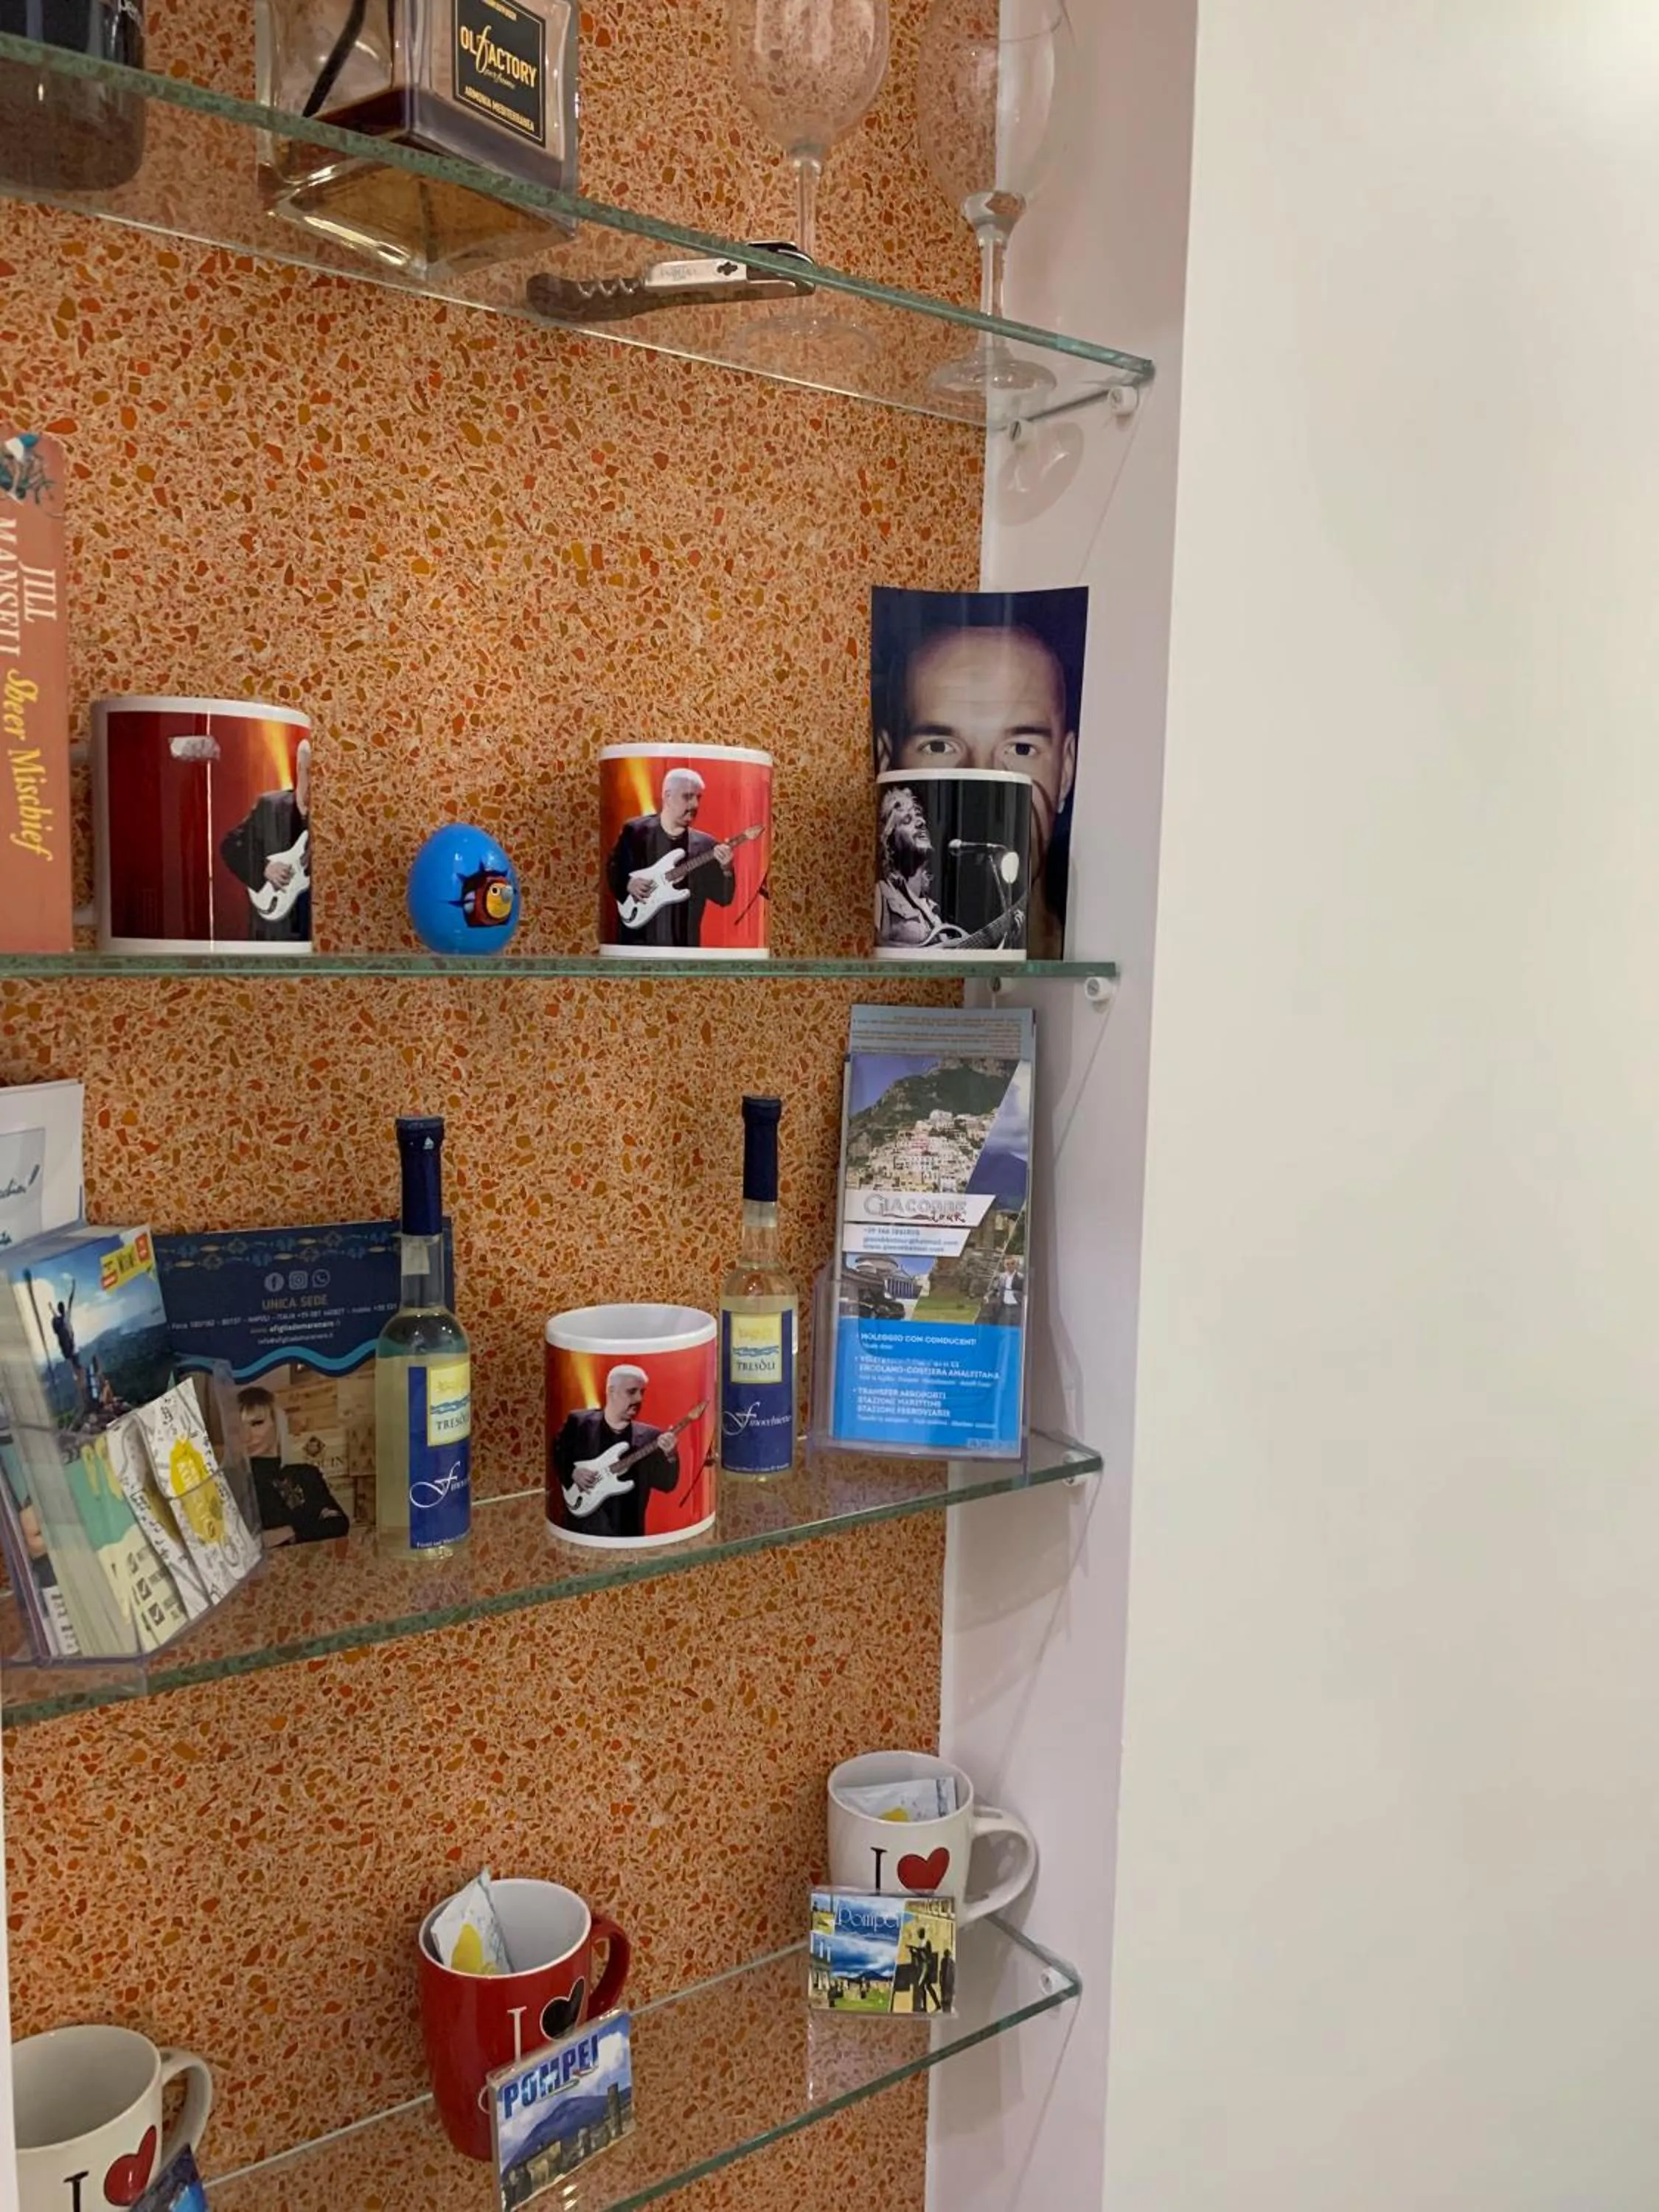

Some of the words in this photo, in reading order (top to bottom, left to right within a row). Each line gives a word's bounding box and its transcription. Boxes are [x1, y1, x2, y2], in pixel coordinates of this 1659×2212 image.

[18, 560, 57, 622] JILL
[2, 668, 39, 742] Sheer
[9, 746, 53, 861] Mischief
[261, 1296, 296, 1311] UNICA
[299, 1294, 328, 1307] SEDE
[870, 1846, 888, 1894] I
[507, 2006, 527, 2065] I
[502, 2034, 599, 2119] POMPEI
